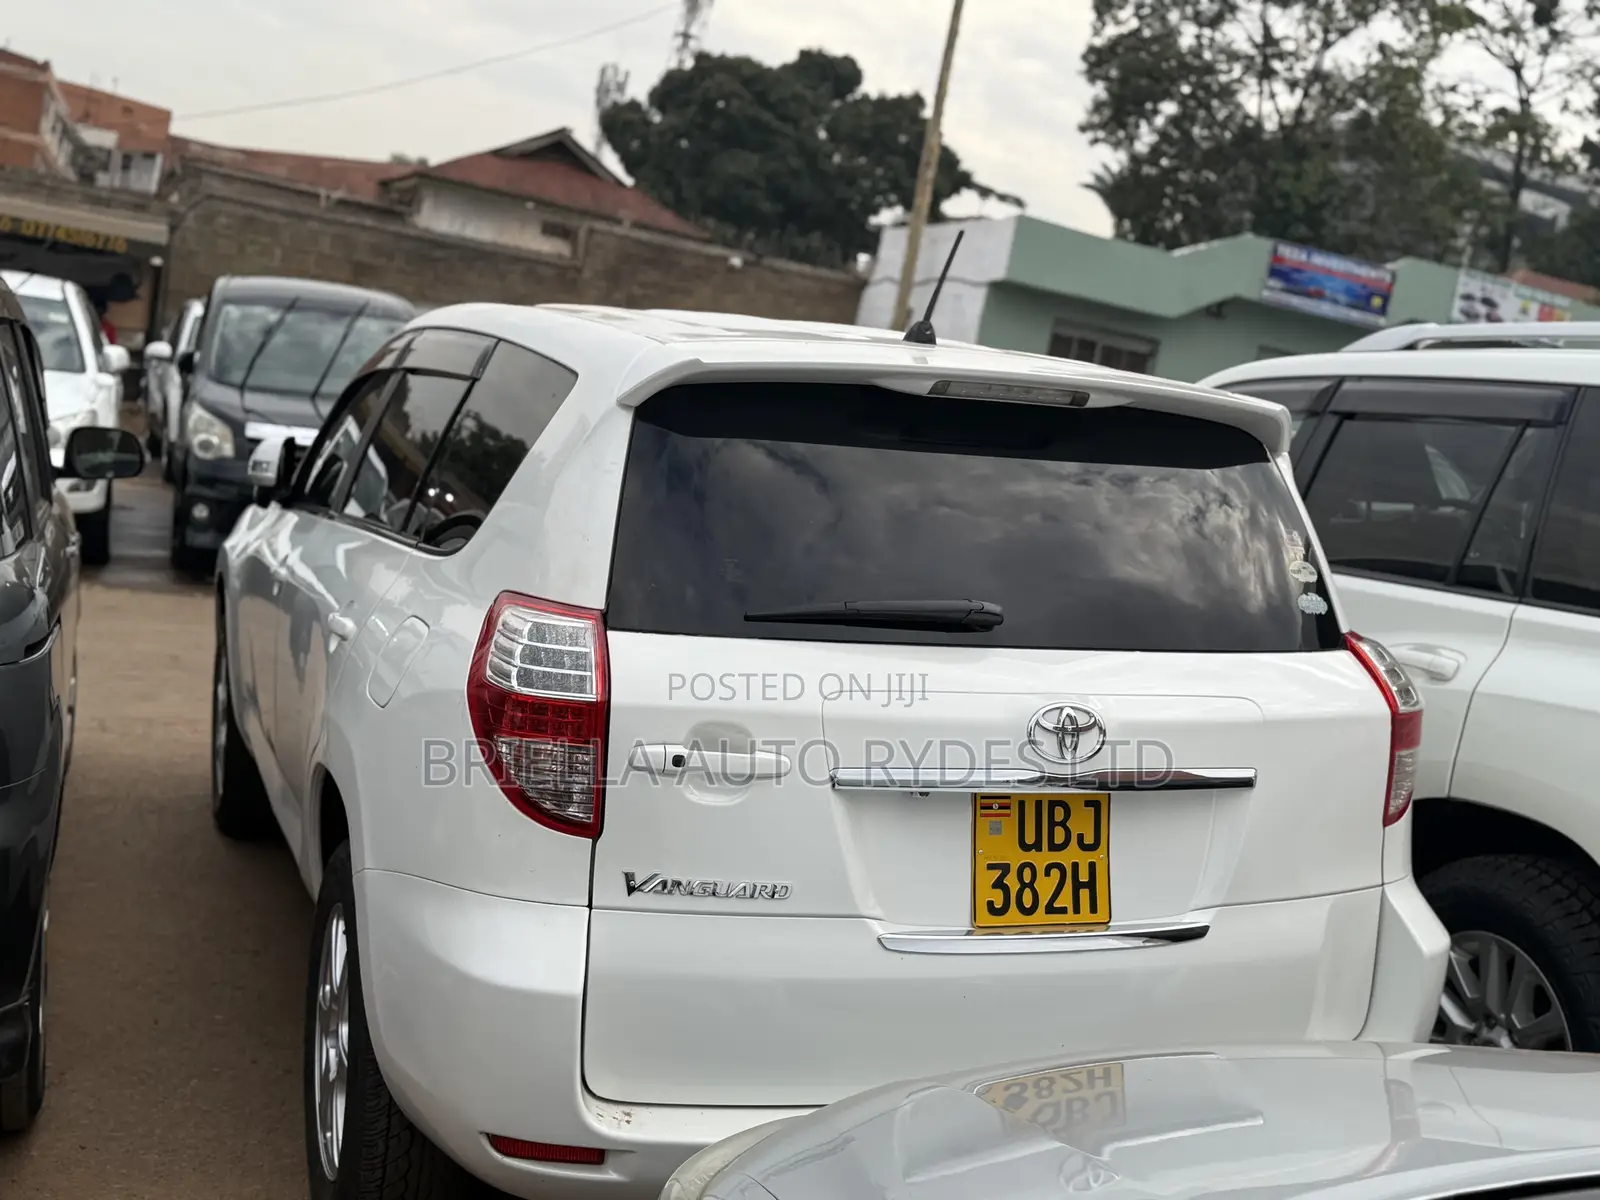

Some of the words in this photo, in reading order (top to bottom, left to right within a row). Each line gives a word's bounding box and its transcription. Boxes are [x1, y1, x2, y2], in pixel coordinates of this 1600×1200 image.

[1017, 799, 1102, 853] UBJ
[621, 870, 793, 900] VANGUARD
[986, 860, 1099, 917] 382H
